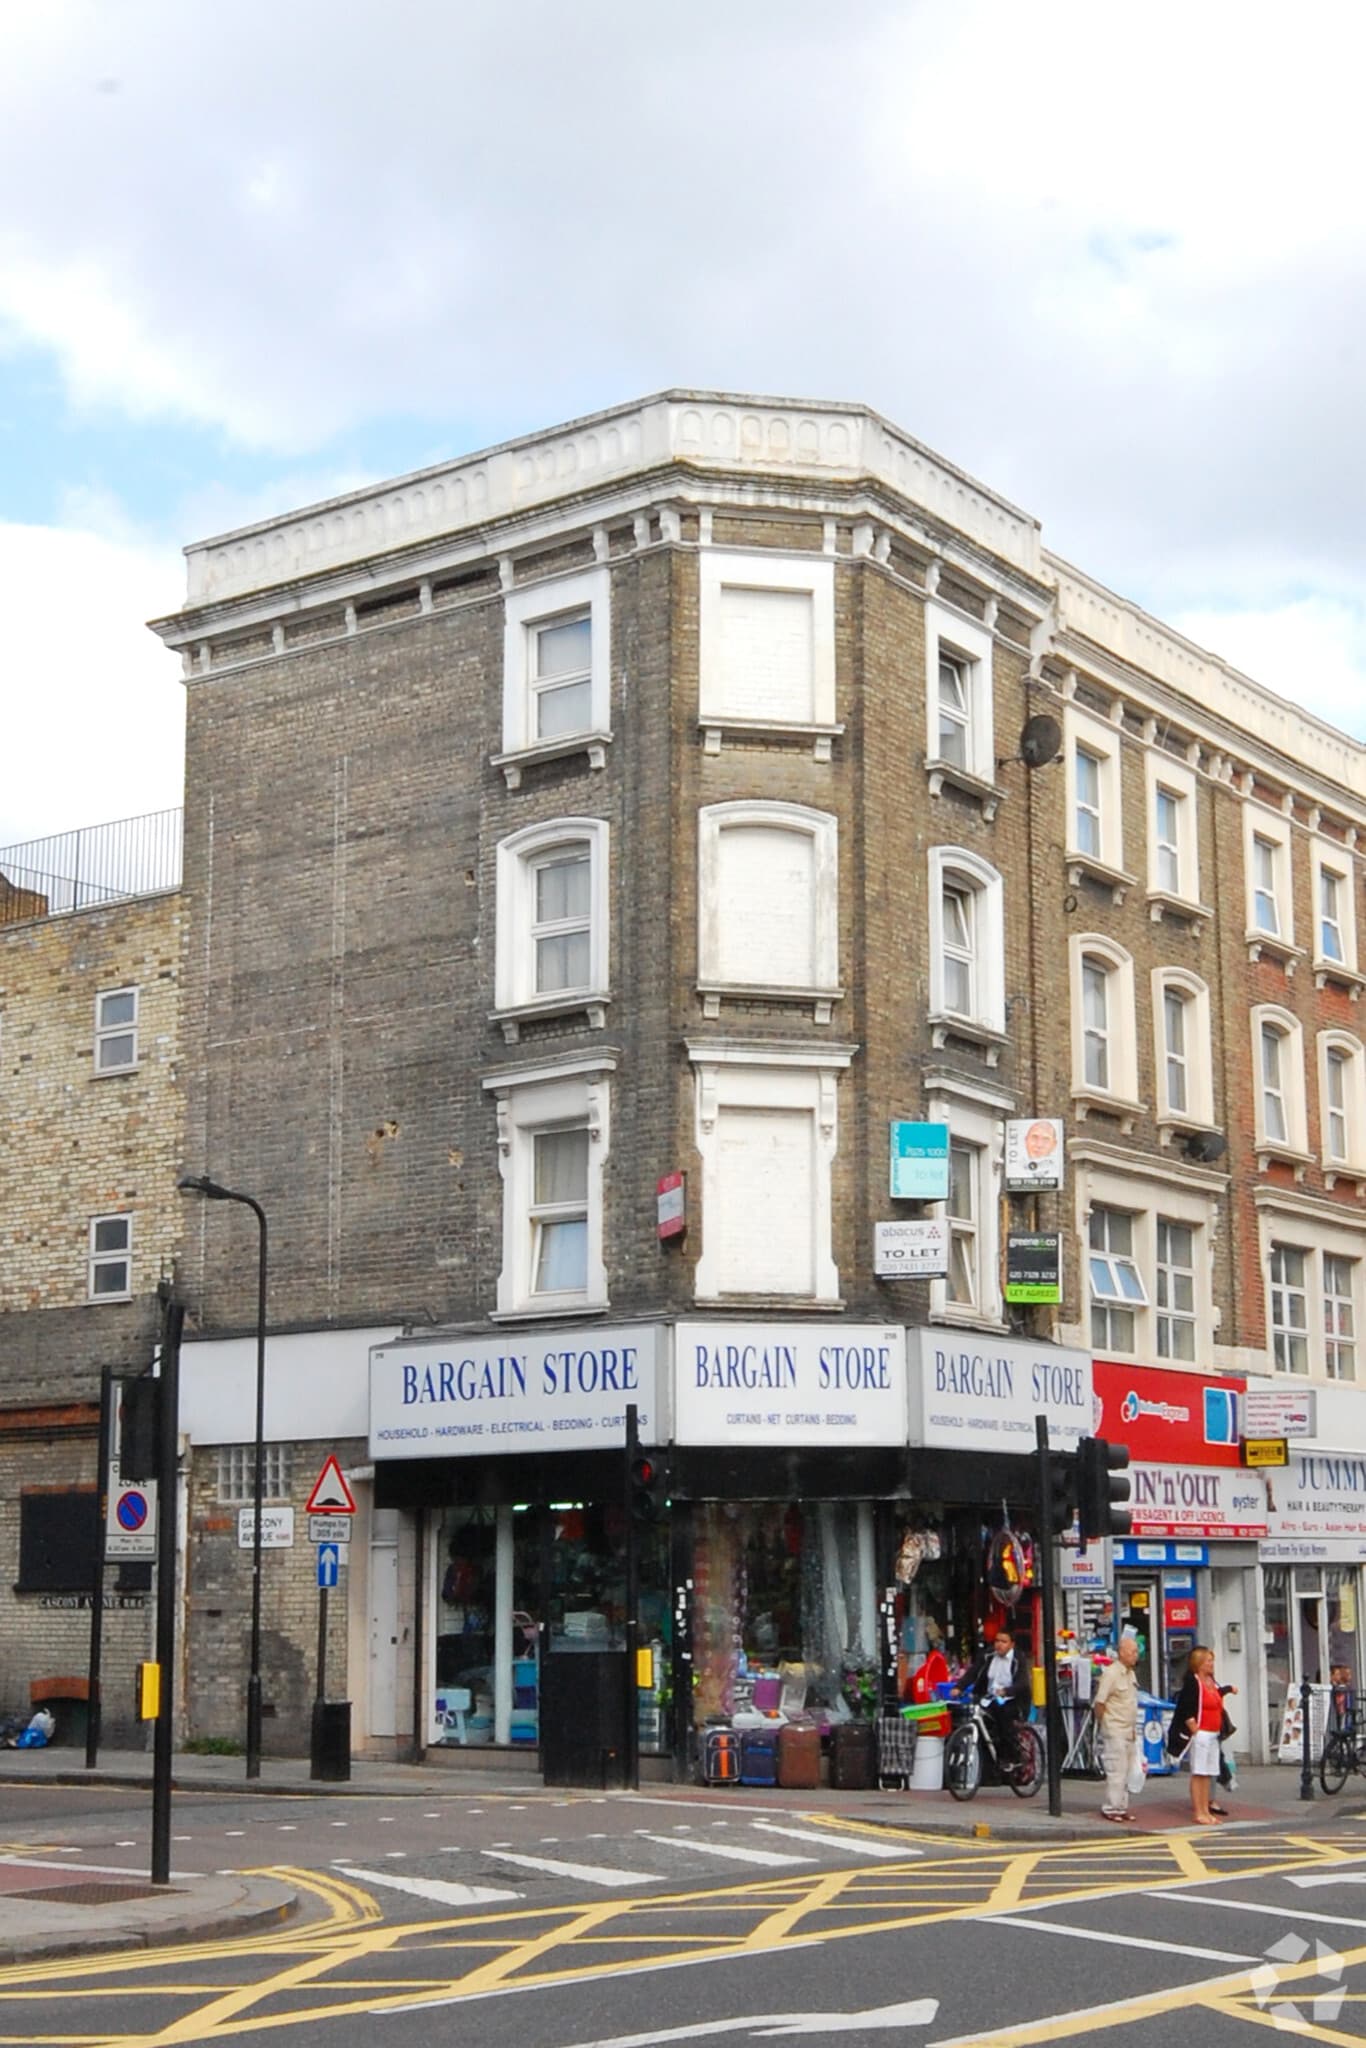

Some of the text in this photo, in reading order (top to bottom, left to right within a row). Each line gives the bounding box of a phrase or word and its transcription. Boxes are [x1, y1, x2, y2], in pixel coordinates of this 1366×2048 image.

[1008, 1128, 1018, 1164] TO LET
[882, 1226, 925, 1237] abacus
[882, 1247, 940, 1258] TO LET
[1009, 1289, 1057, 1297] LET AGREED
[695, 1345, 891, 1389] BARGAIN STORE
[402, 1348, 638, 1404] BARGAIN STORE
[935, 1351, 1085, 1406] BARGAIN STORE
[726, 1413, 857, 1425] CURTAINS NET CURTAINS BEDDING
[377, 1414, 649, 1440] HOUSEHOLD HARDWARE ELECTRICAL BEDDING CURTNS
[1133, 1470, 1221, 1507] IN'n'OUT
[1232, 1494, 1260, 1512] oyster
[1287, 1501, 1303, 1511] HAIR
[1181, 1510, 1195, 1521] OFF
[1196, 1511, 1225, 1522] LICENCE
[241, 1519, 283, 1528] GACONY
[313, 1519, 337, 1529] Humps
[1072, 1562, 1094, 1572] TOOLS
[1062, 1575, 1103, 1585] ELECTRICAL
